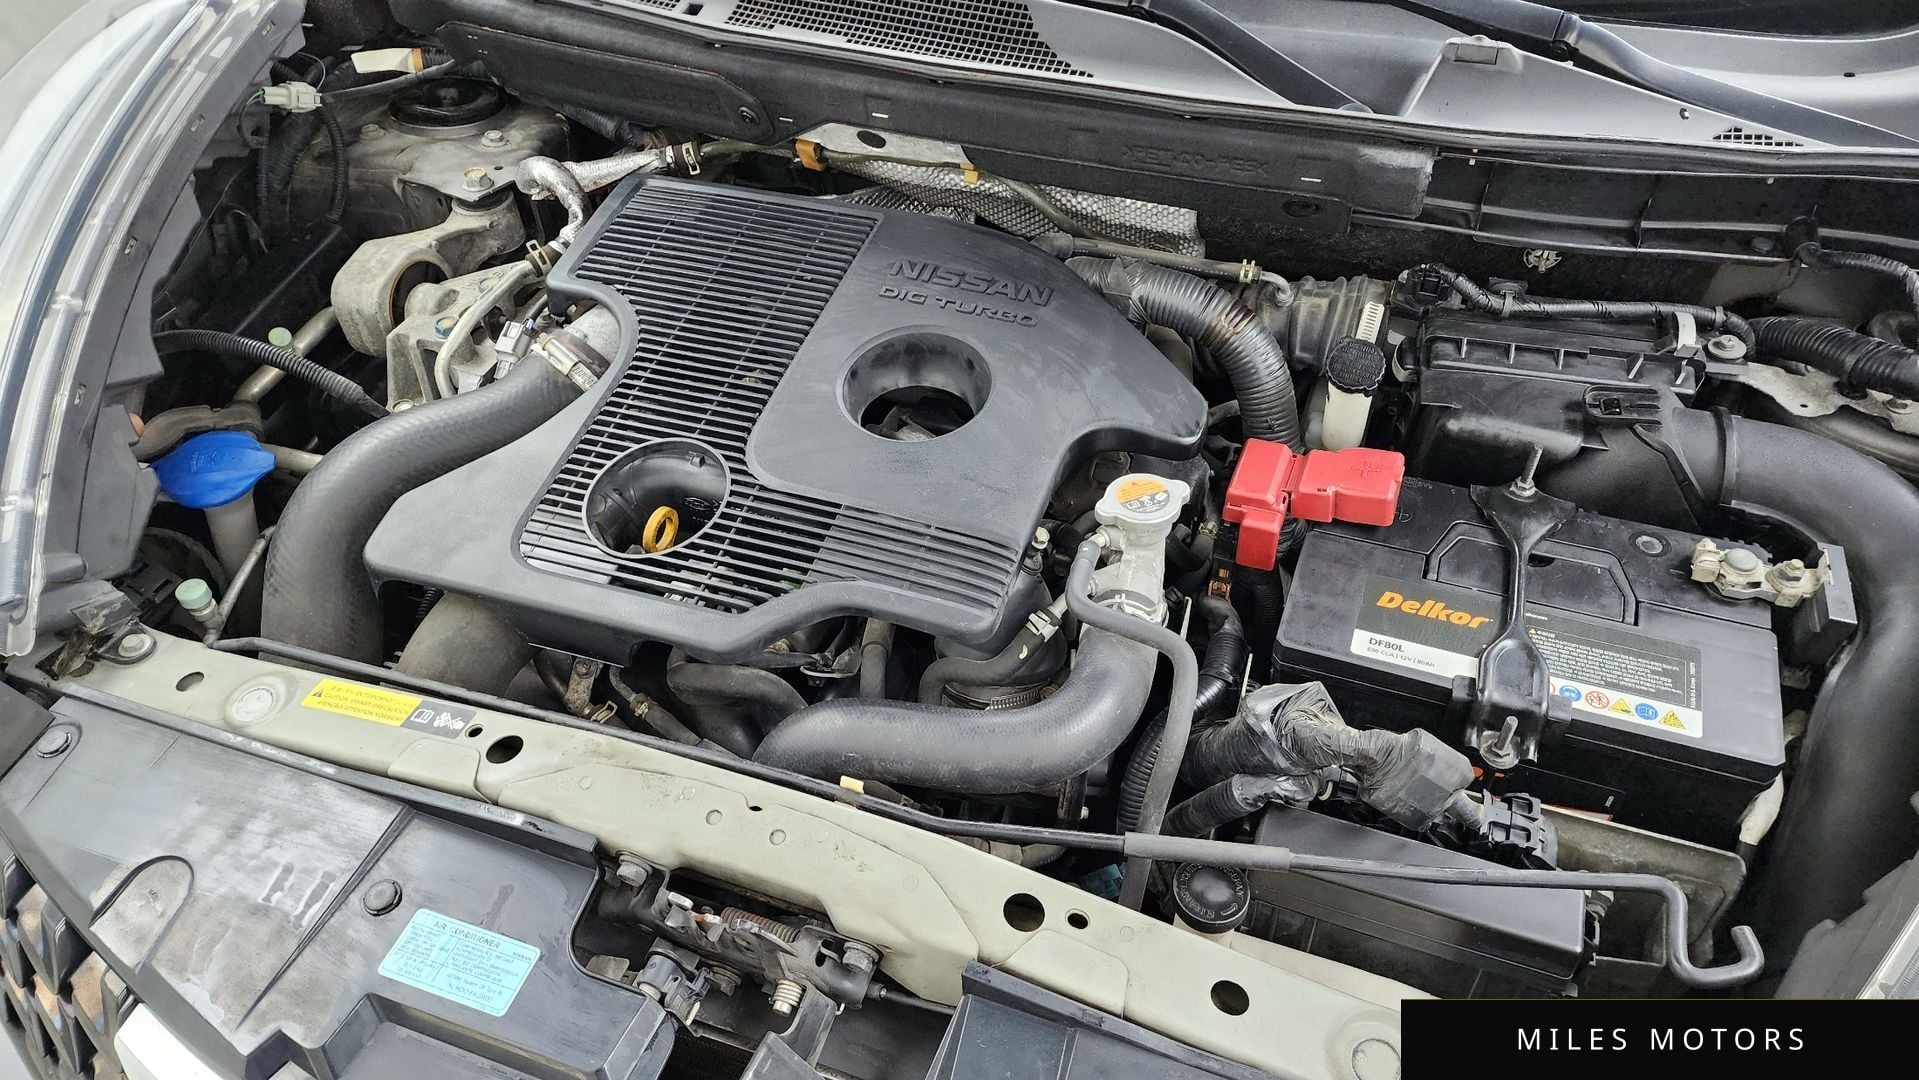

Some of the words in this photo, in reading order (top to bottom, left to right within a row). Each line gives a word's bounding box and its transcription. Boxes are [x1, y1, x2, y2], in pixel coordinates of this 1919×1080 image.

[889, 259, 1054, 307] NISSAN
[878, 285, 929, 306] DIG
[936, 295, 1040, 328] TURBO
[1376, 591, 1490, 629] Delkor
[1368, 637, 1405, 653] DF80L
[433, 920, 447, 931] AIR
[450, 926, 502, 949] CONDITIONER
